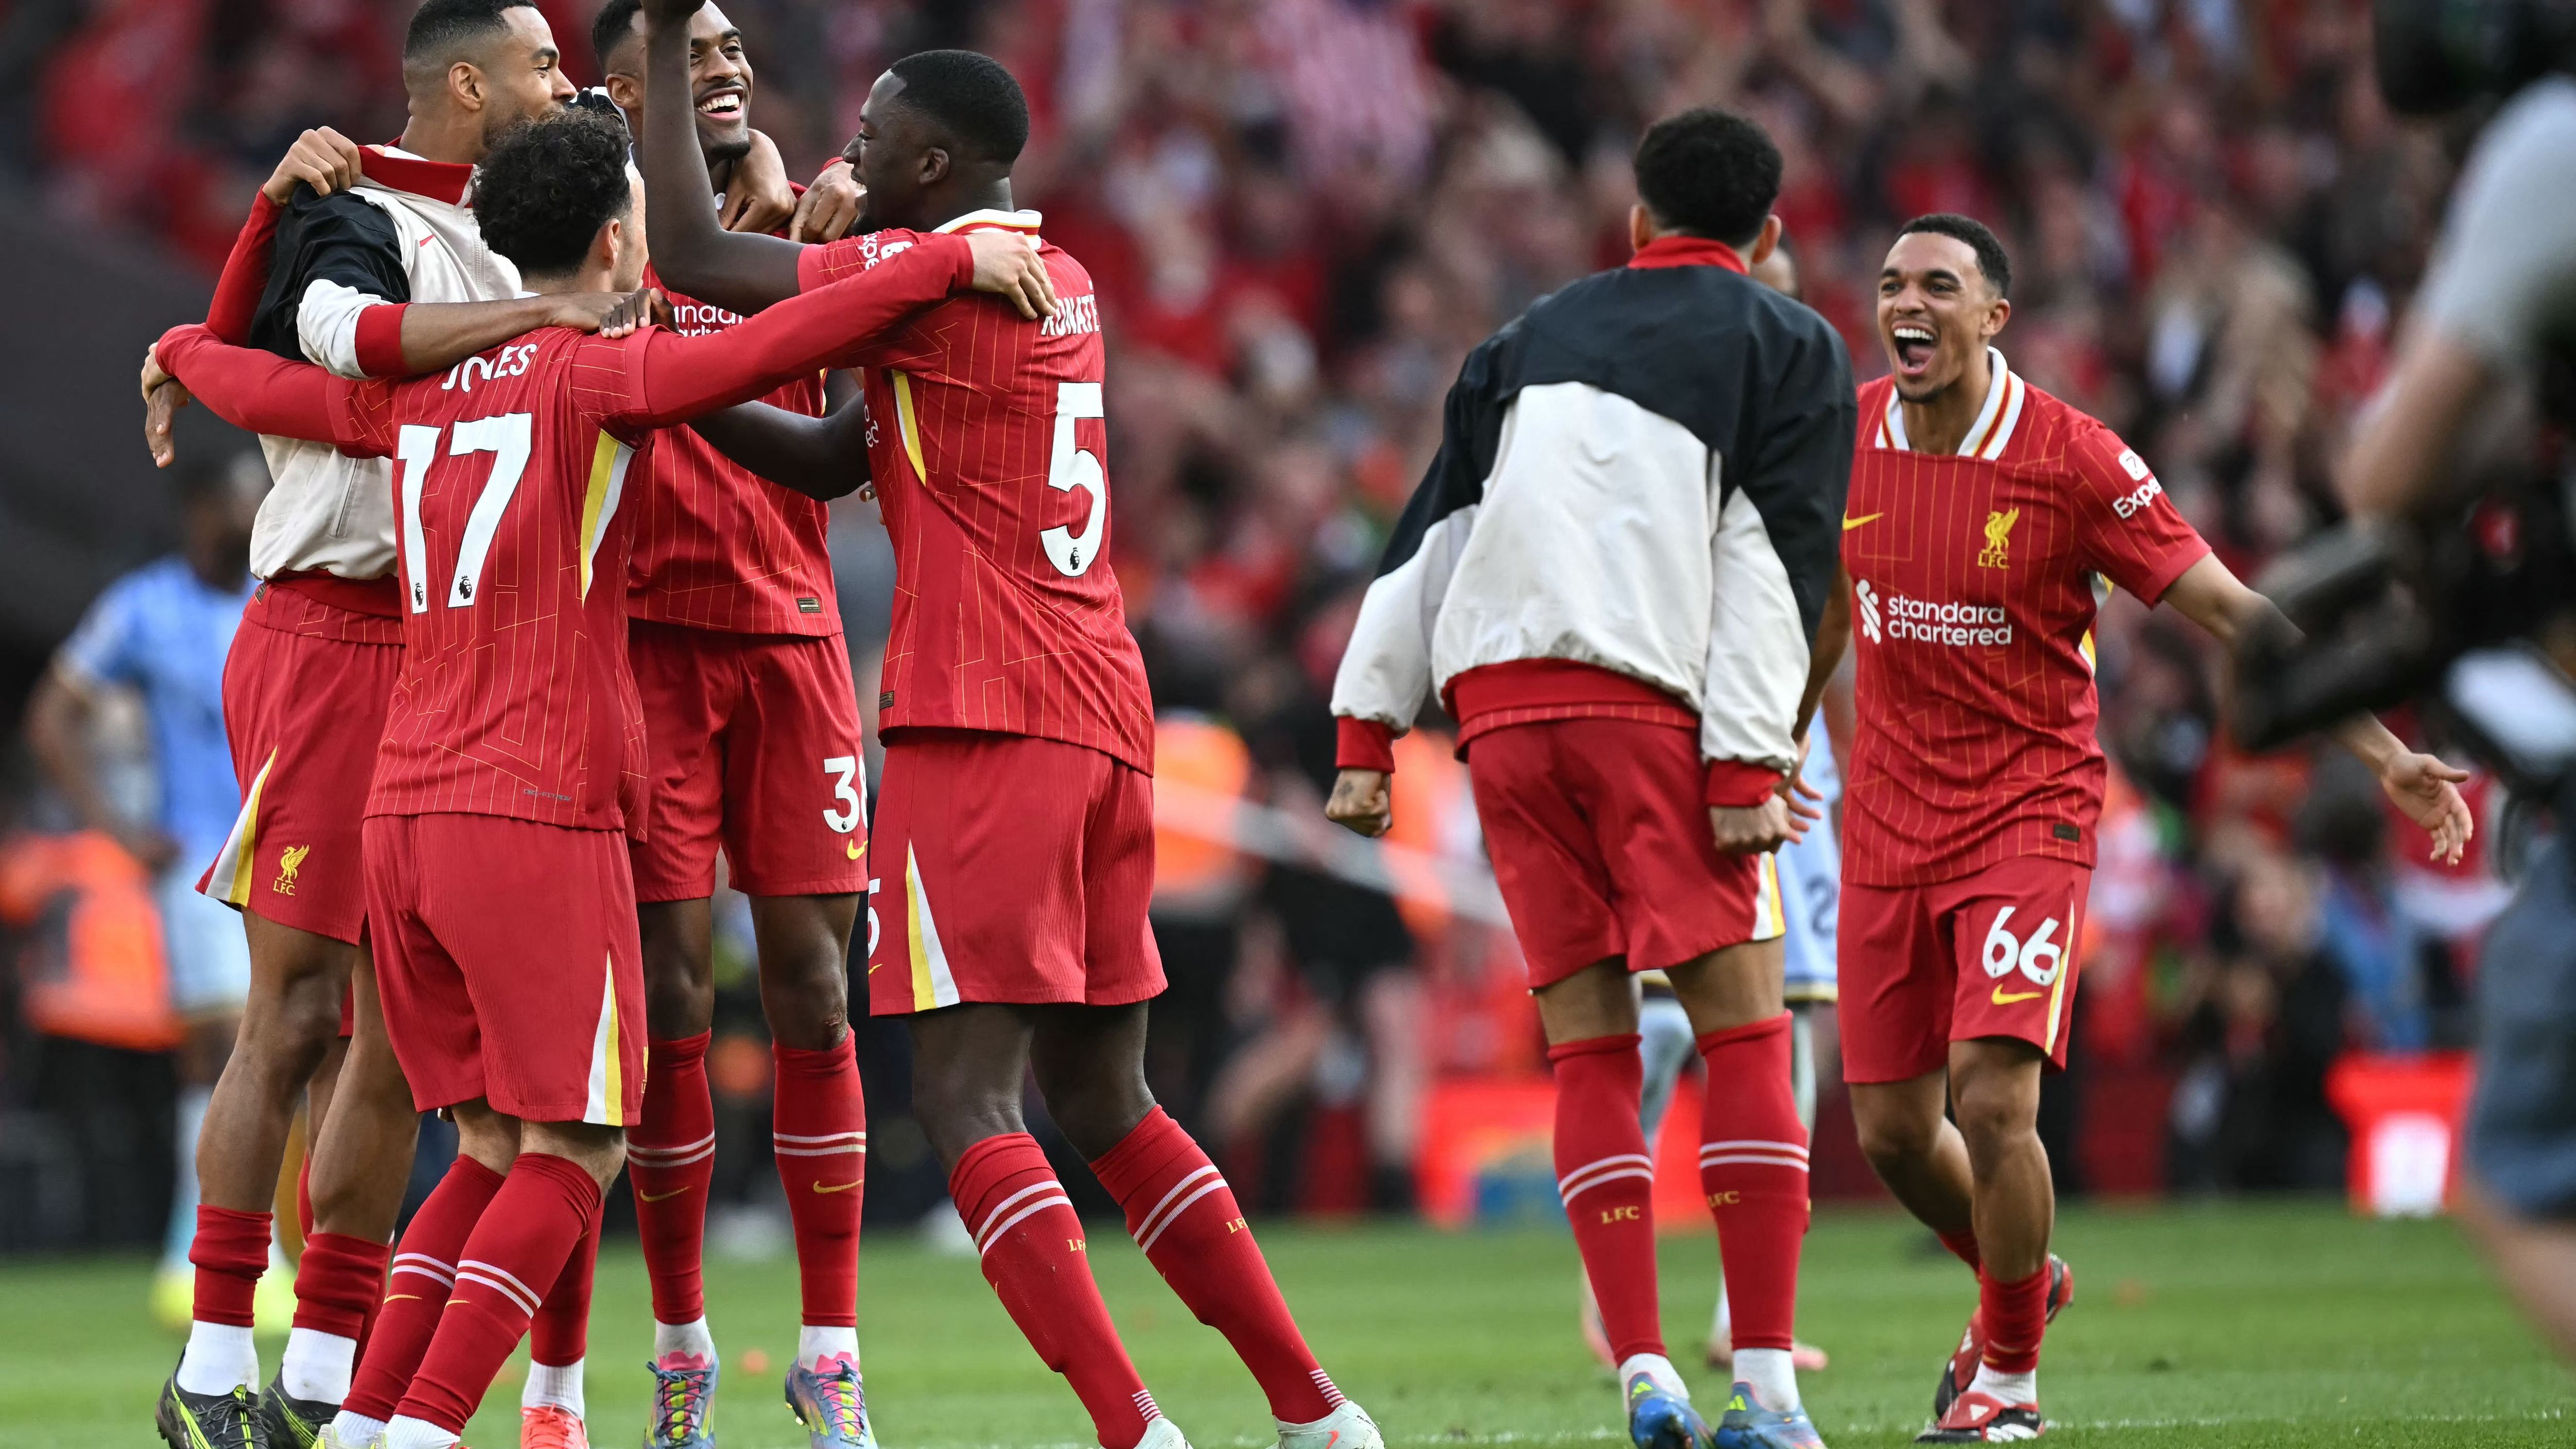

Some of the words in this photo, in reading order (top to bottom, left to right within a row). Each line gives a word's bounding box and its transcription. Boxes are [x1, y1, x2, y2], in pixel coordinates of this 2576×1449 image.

[397, 412, 532, 614] 17
[1040, 381, 1106, 577] 5
[1888, 617, 2012, 647] chartered
[1982, 906, 2061, 987] 66
[1601, 1206, 1641, 1225] LFC
